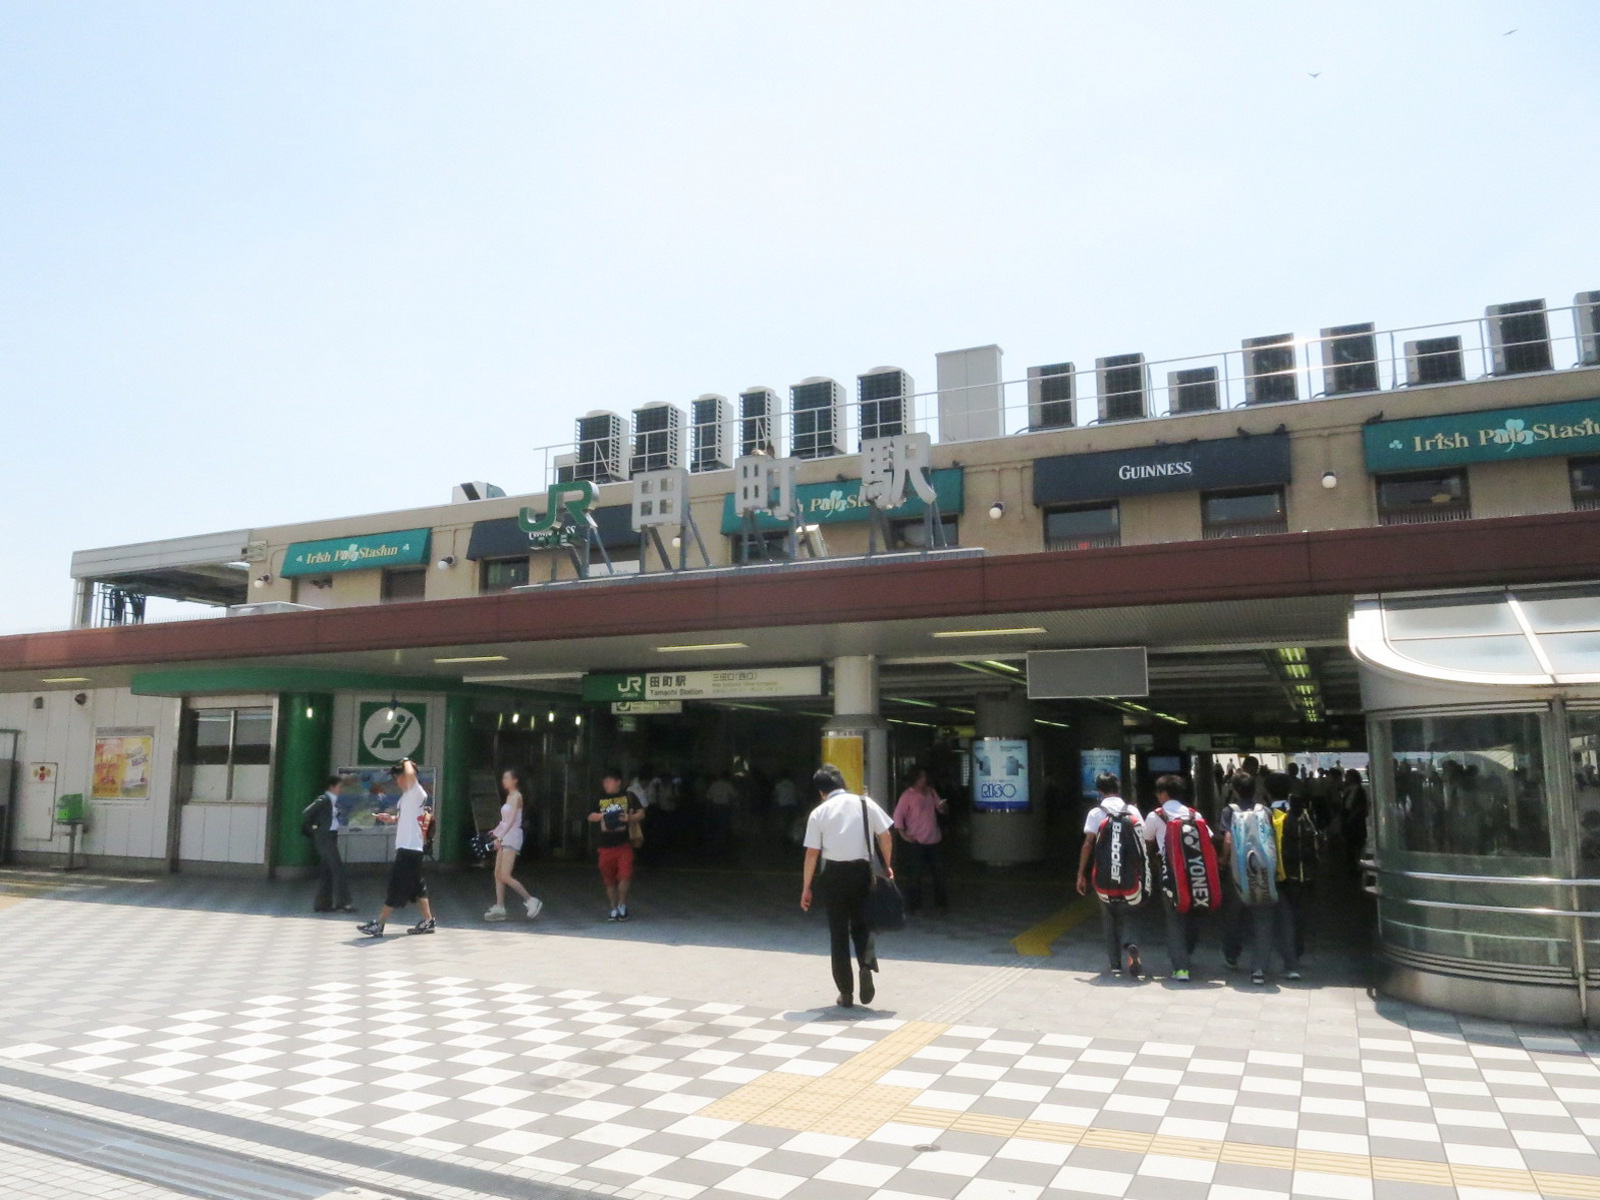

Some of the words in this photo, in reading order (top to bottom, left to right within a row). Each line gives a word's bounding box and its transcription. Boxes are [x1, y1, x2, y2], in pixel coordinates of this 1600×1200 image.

[1414, 432, 1469, 452] Irish
[1479, 427, 1527, 446] Pub
[518, 480, 596, 533] JR
[305, 552, 331, 565] Irish
[618, 676, 642, 693] JR
[649, 675, 687, 688] 田町駅
[650, 689, 678, 697] Tamachi
[679, 688, 704, 696] Station
[981, 783, 1016, 798] RISO
[1110, 821, 1122, 885] Babolat
[1187, 854, 1210, 908] YONEX
